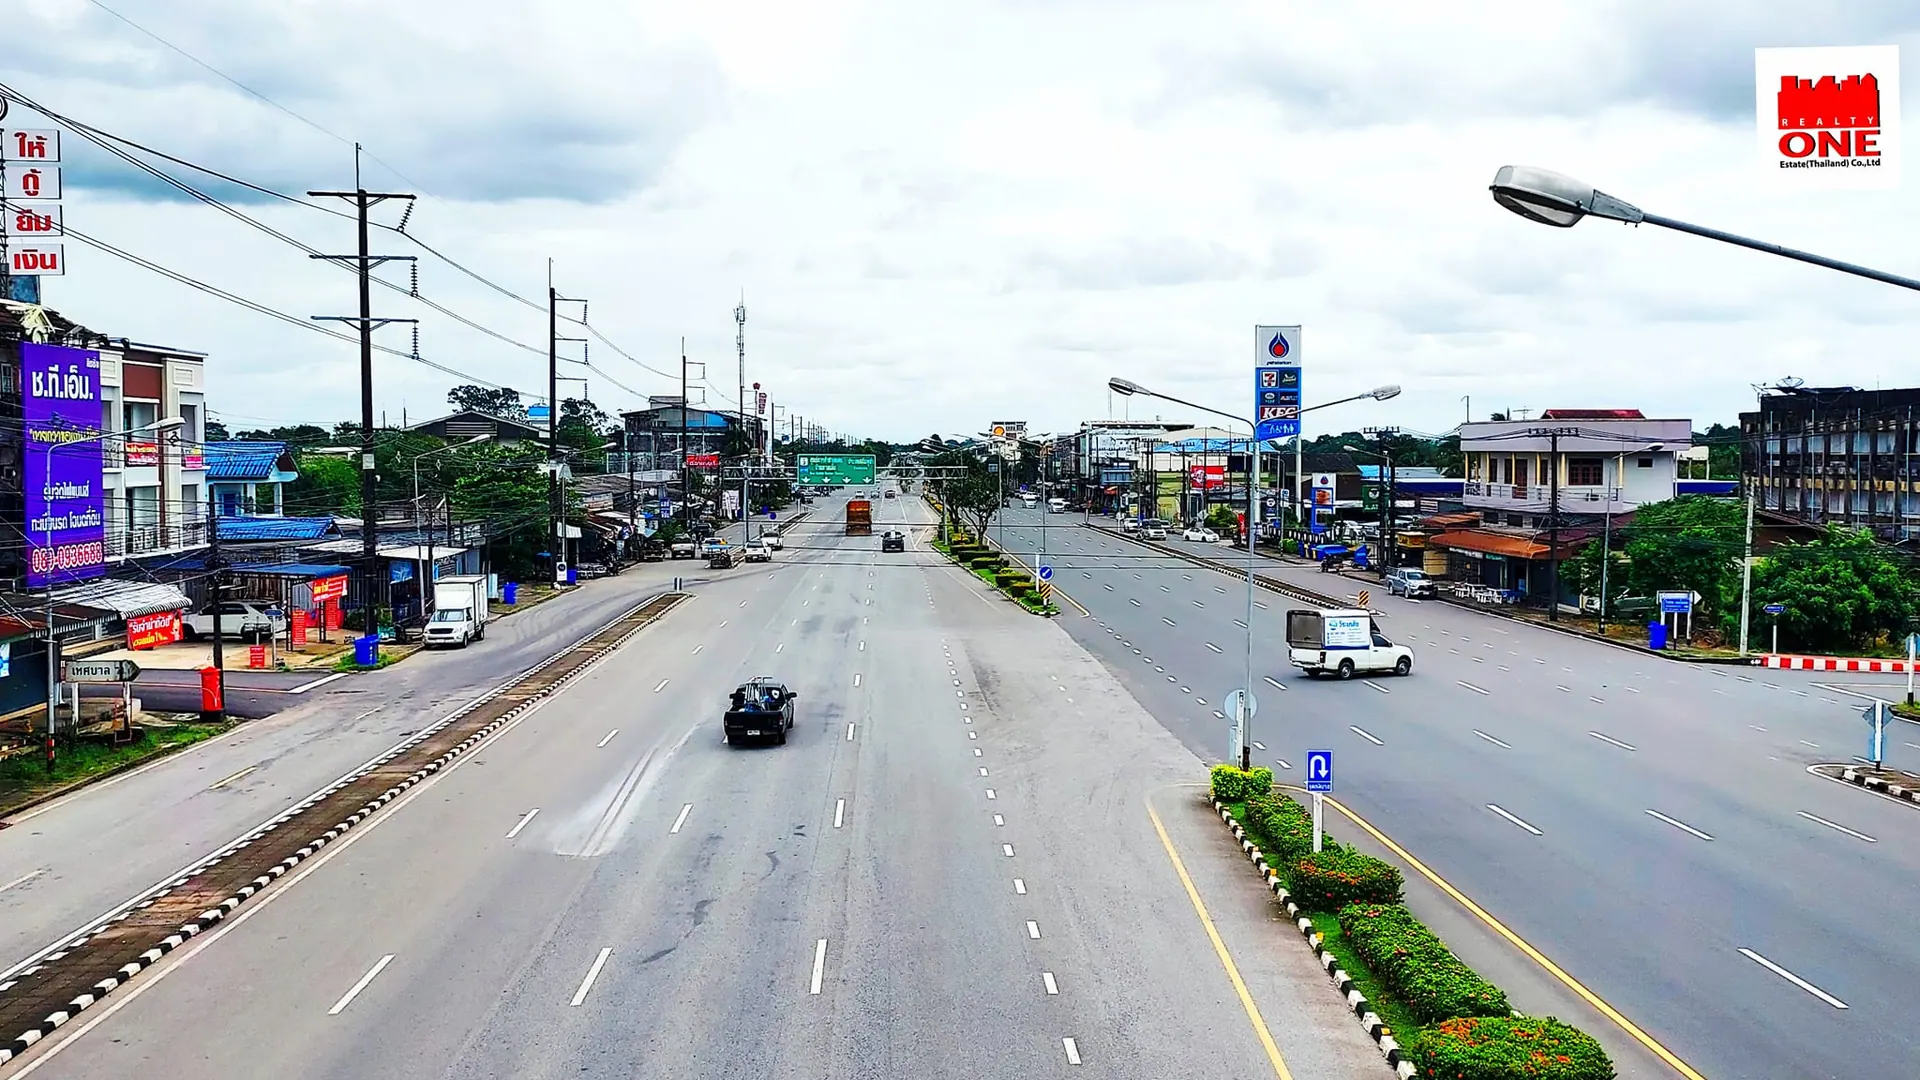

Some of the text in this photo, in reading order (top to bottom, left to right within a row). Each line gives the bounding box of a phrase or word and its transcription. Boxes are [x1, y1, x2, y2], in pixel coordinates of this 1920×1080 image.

[14, 132, 47, 158] ให้
[22, 168, 42, 197] กู้
[14, 248, 57, 270] เงิน
[72, 666, 111, 676] เทศบาล
